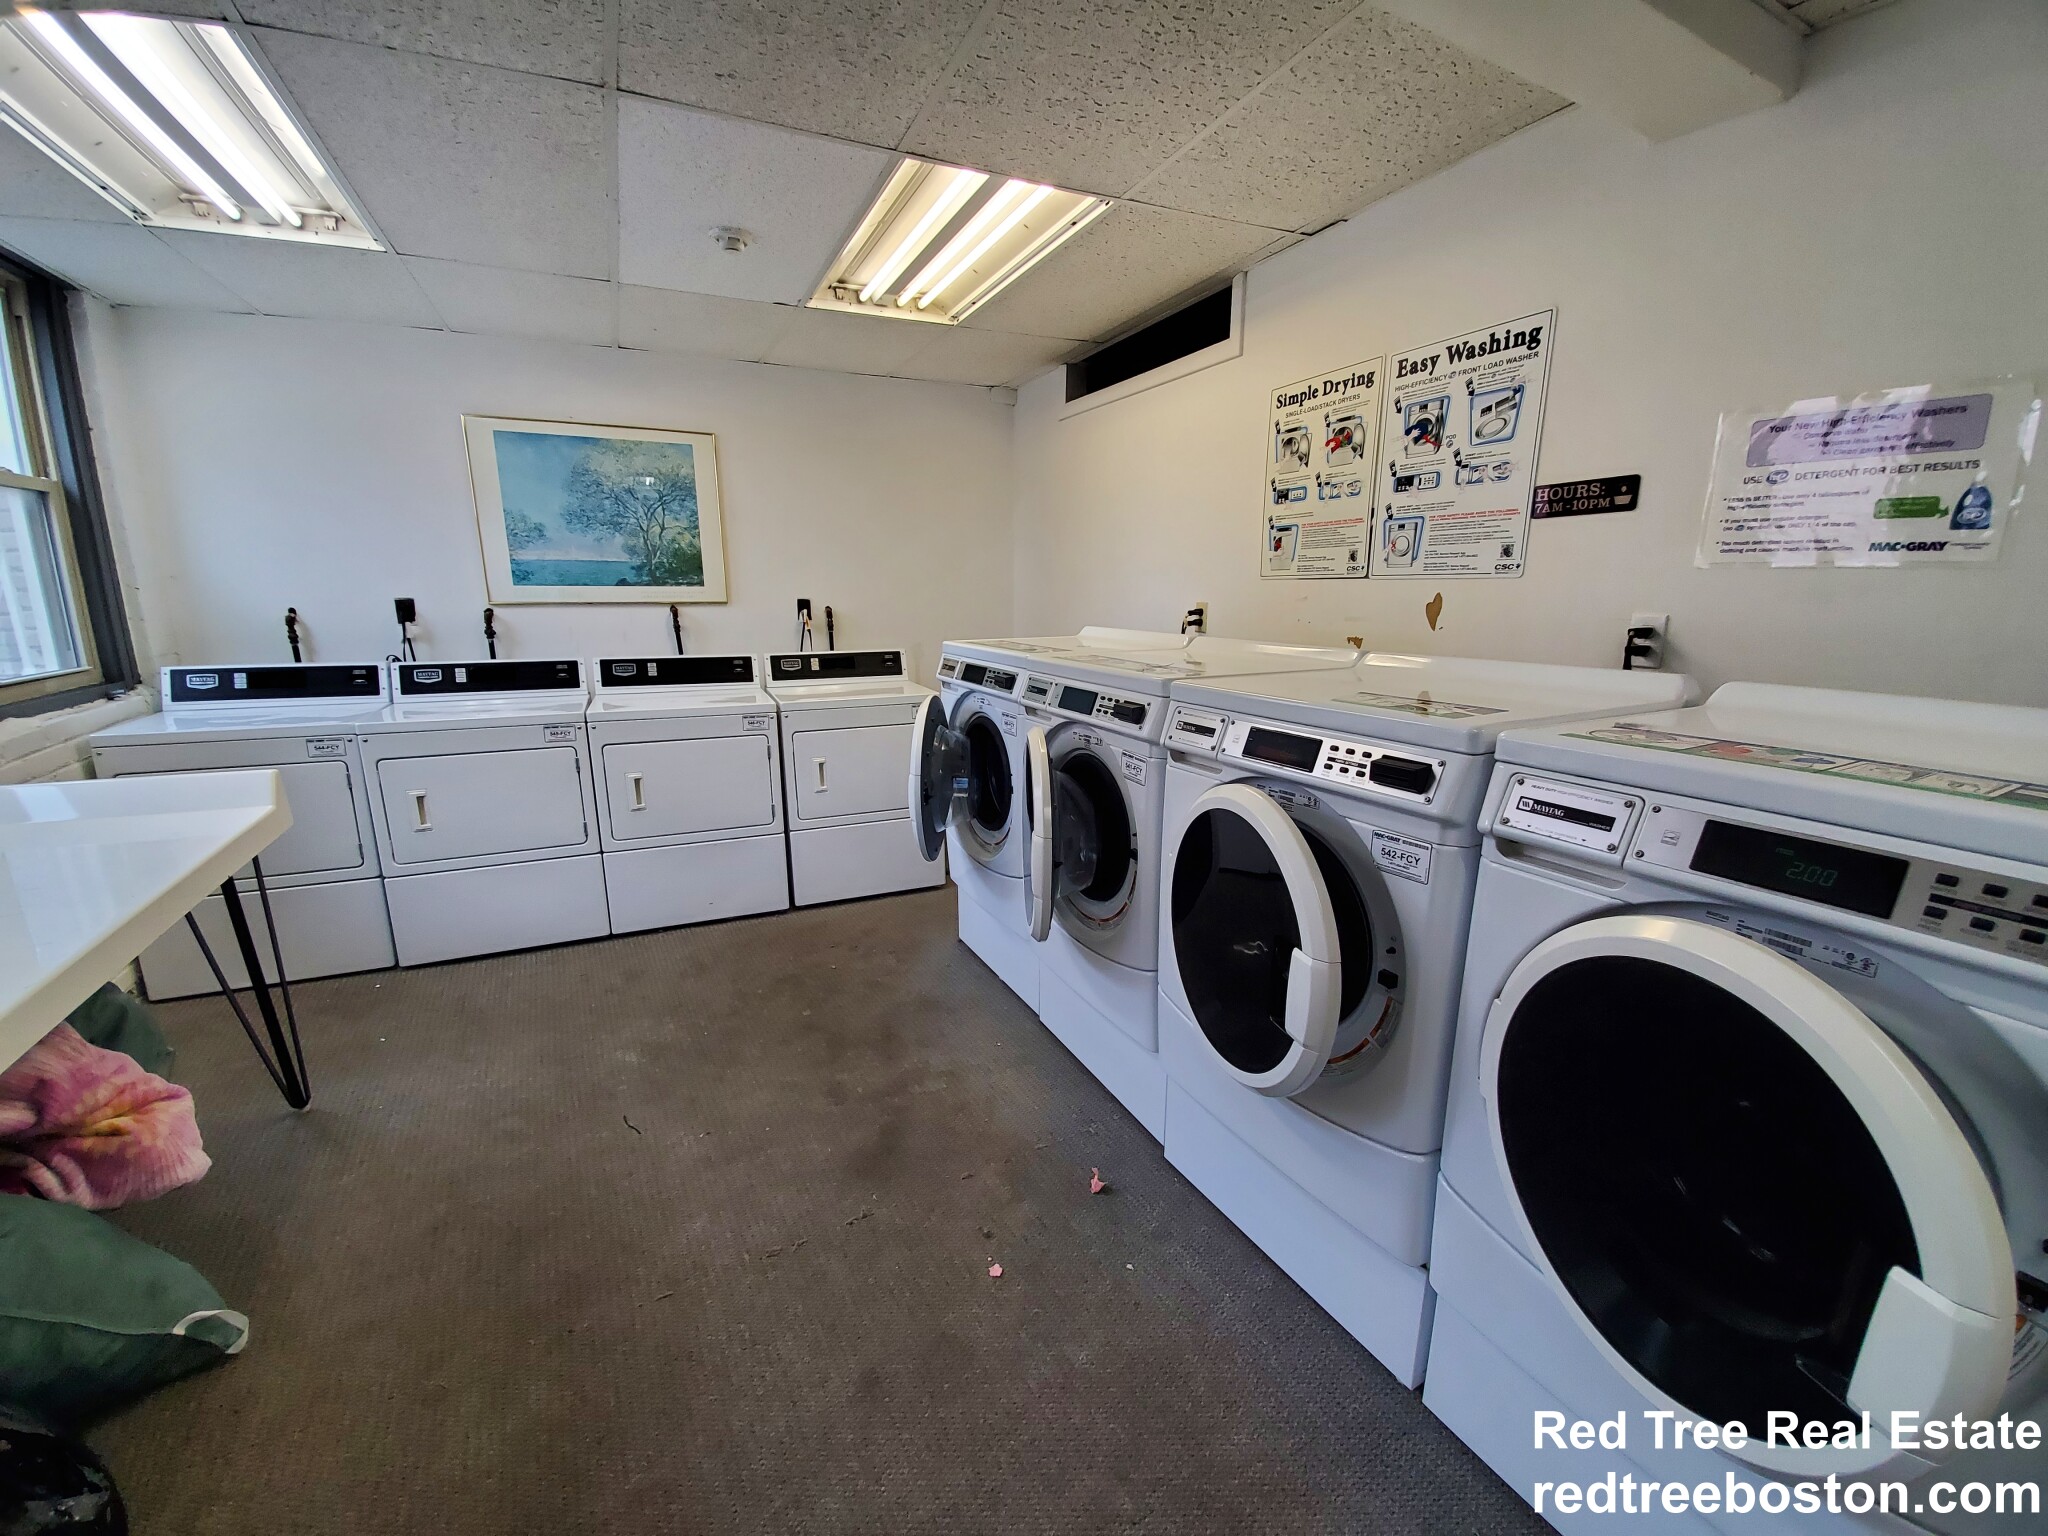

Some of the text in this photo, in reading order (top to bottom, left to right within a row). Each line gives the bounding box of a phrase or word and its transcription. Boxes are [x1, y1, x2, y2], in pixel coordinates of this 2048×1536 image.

[1395, 354, 1441, 379] Easy
[1445, 325, 1544, 365] Washing
[1394, 373, 1448, 392] HIGH-EFFICIENCY
[1457, 365, 1482, 377] FRONT
[1483, 359, 1504, 371] LOAD
[1505, 350, 1540, 365] WASHER
[1275, 384, 1319, 409] Simple
[1321, 370, 1376, 396] Drying
[1337, 393, 1361, 404] DRYERS
[1769, 424, 1792, 434] Your
[1794, 421, 1818, 431] New
[1912, 405, 1968, 418] Washers
[1743, 475, 1764, 486] USE
[1795, 468, 1860, 481] DETERGENT
[1862, 466, 1887, 477] FOR
[1889, 463, 1922, 475] BEST
[1923, 459, 1981, 473] RESULTS
[1535, 482, 1606, 501] HOURS:
[1494, 563, 1515, 571] CSC
[1532, 803, 1565, 817] MAYTAG
[1380, 847, 1421, 866] 542-FCY
